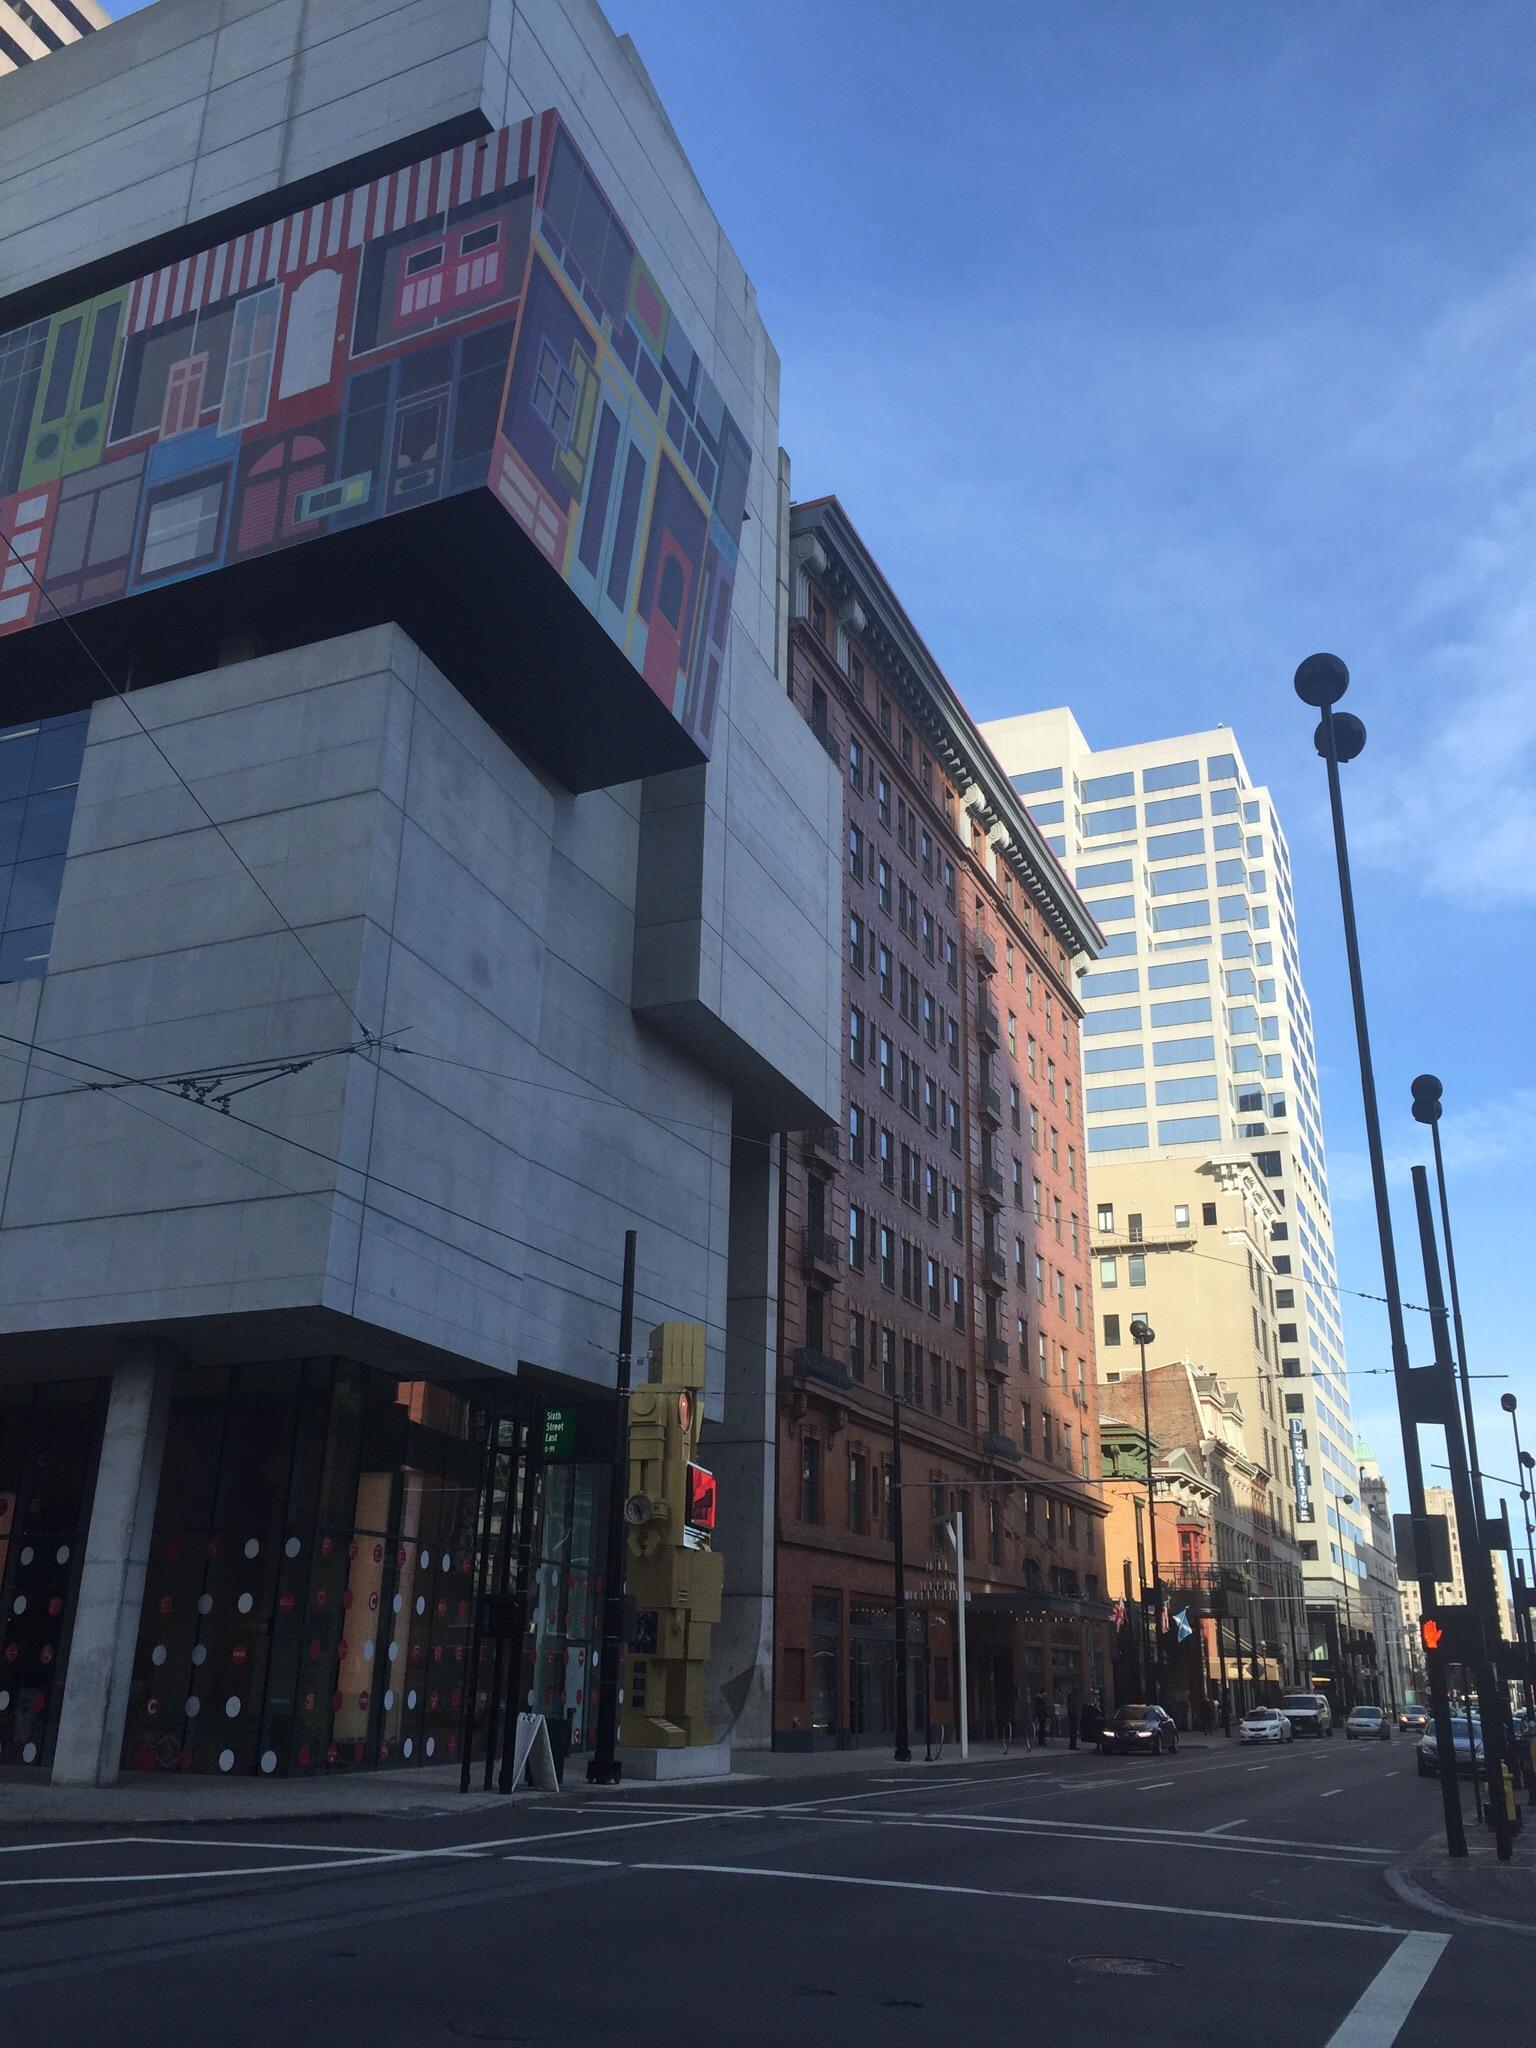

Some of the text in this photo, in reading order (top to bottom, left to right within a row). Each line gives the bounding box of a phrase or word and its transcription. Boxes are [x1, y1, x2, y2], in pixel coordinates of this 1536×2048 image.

[547, 1410, 562, 1420] Sixth
[546, 1421, 564, 1431] Street
[545, 1432, 558, 1442] East
[1295, 1440, 1304, 1460] NOW
[1297, 1462, 1308, 1509] LEASING
